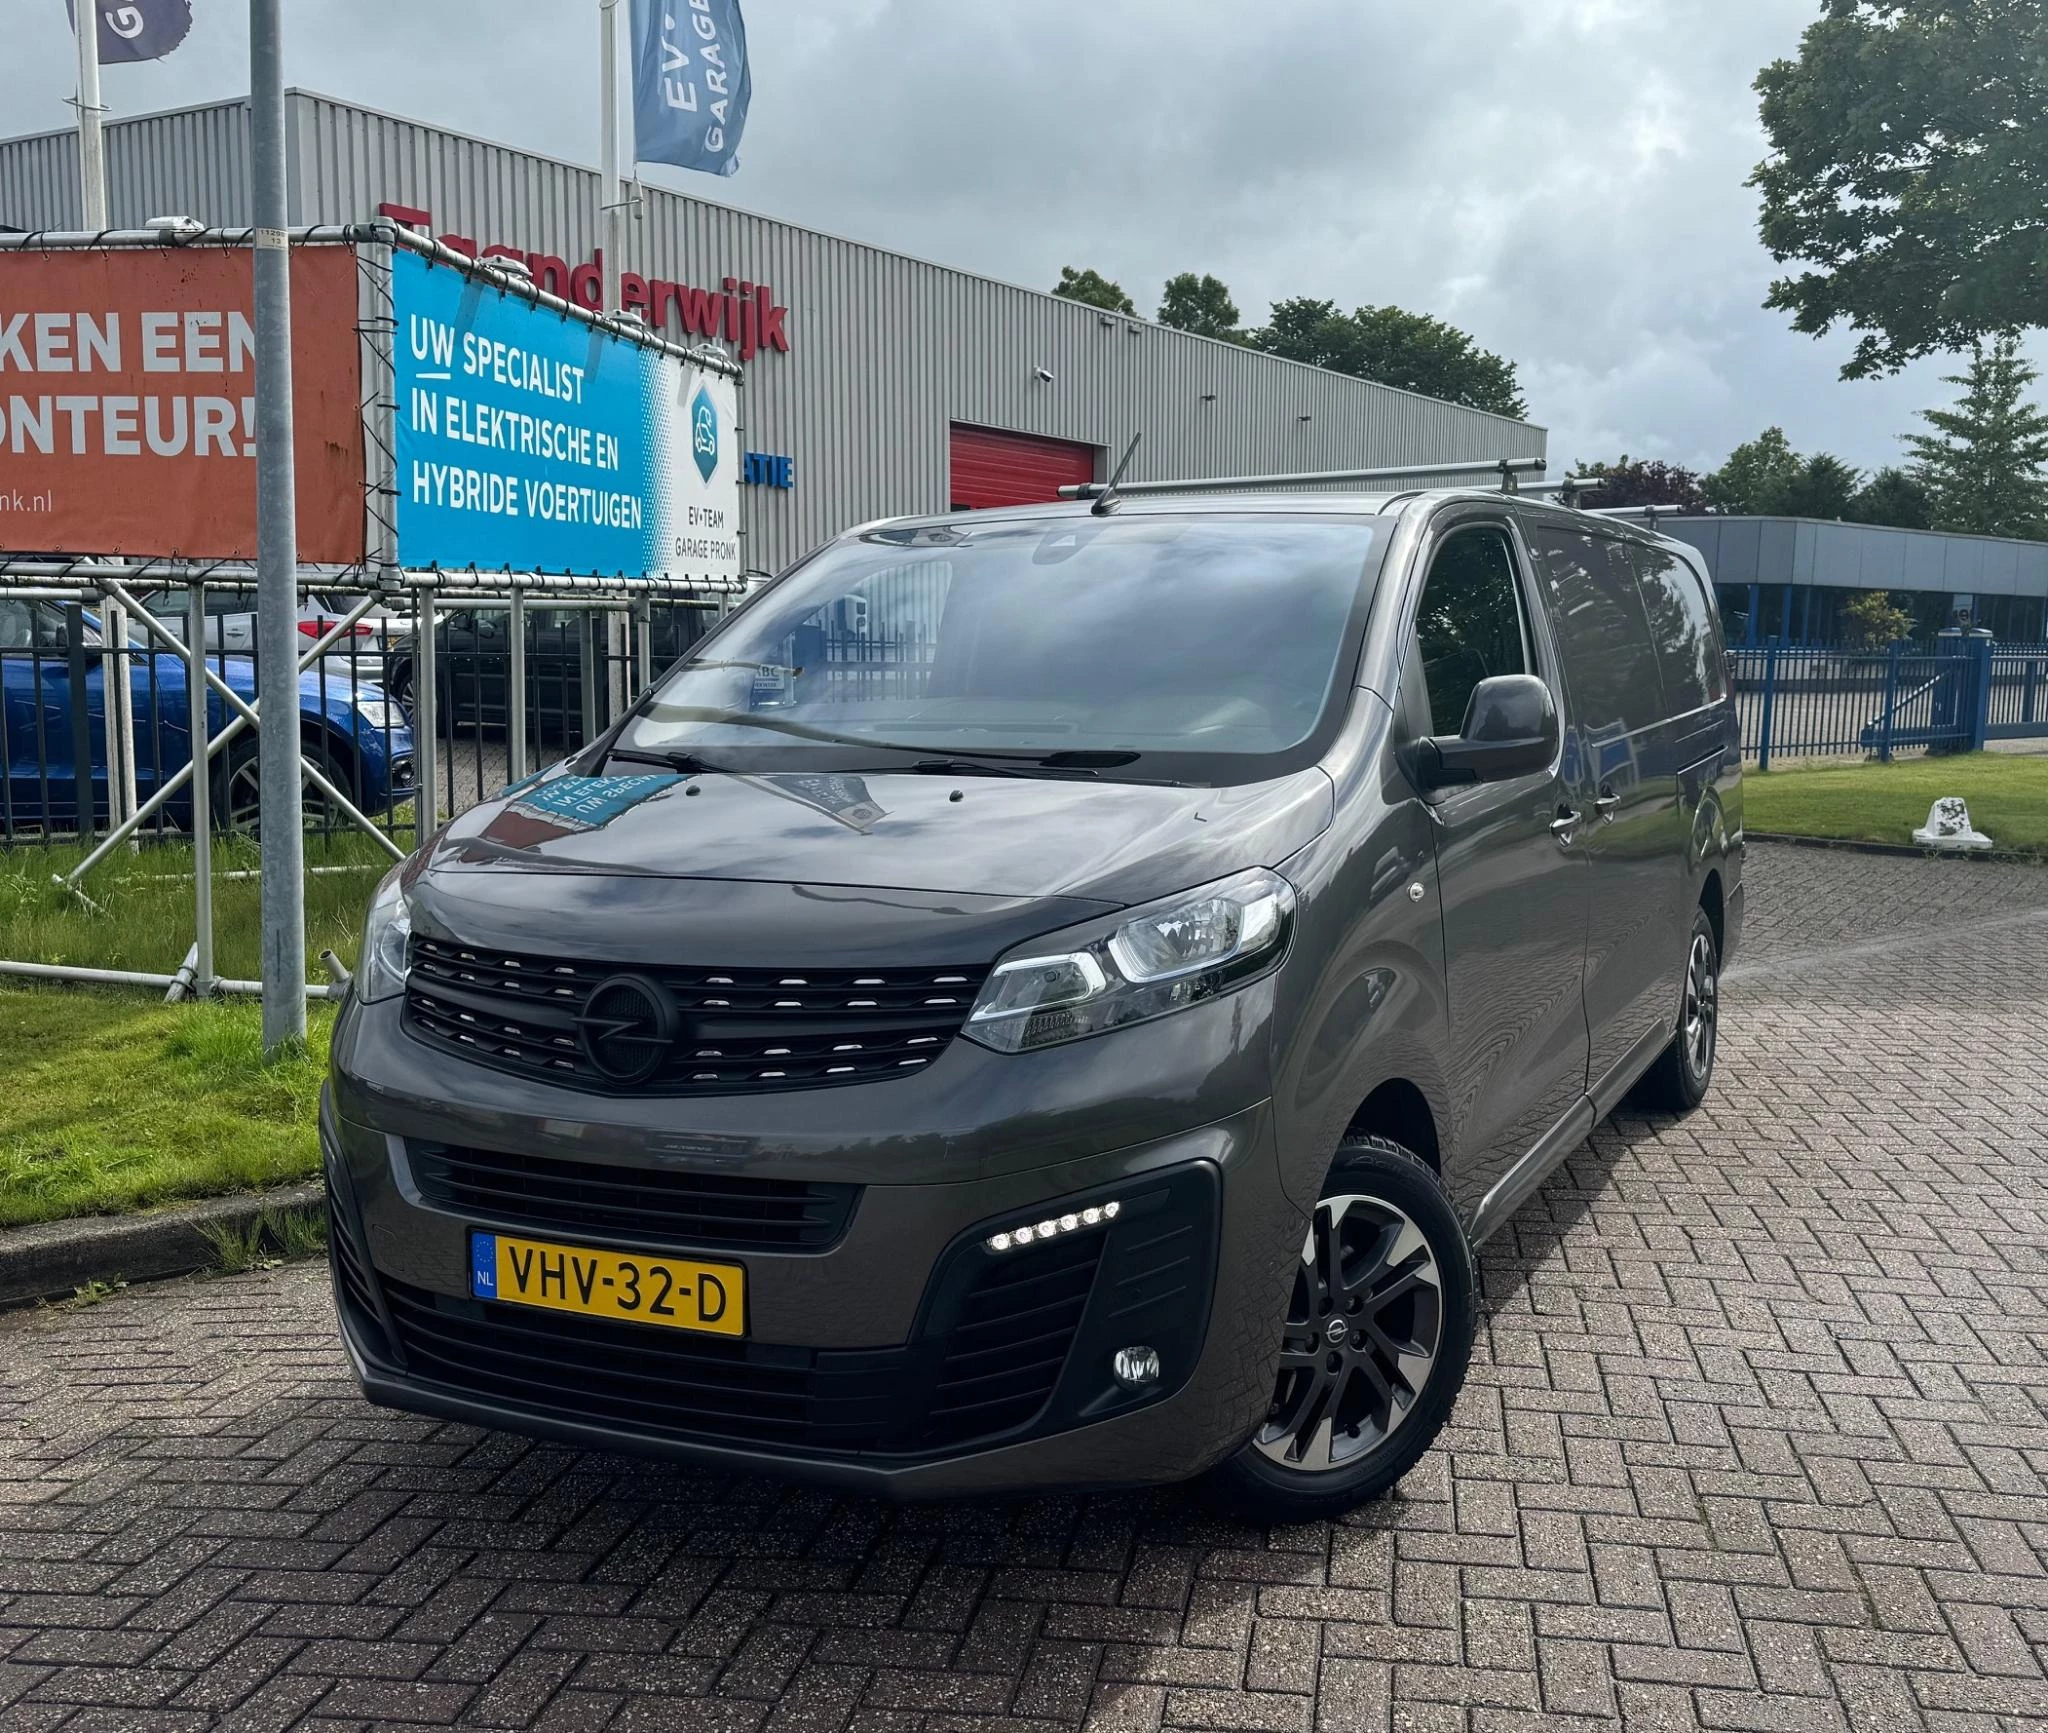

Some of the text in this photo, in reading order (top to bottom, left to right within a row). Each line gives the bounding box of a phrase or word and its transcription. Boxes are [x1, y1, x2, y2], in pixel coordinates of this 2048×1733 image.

[105, 0, 144, 39] G
[0, 312, 122, 372] KEN
[411, 313, 584, 404] UW SPECIALIST
[0, 395, 257, 457] NTEUR!
[411, 387, 618, 471] IN ELEKTRISCHE EN
[413, 459, 641, 529] HYBRIDE VOERTUIGEN
[675, 537, 736, 560] GARAGE PRONK
[477, 1246, 726, 1322] NL VHV-32-D
